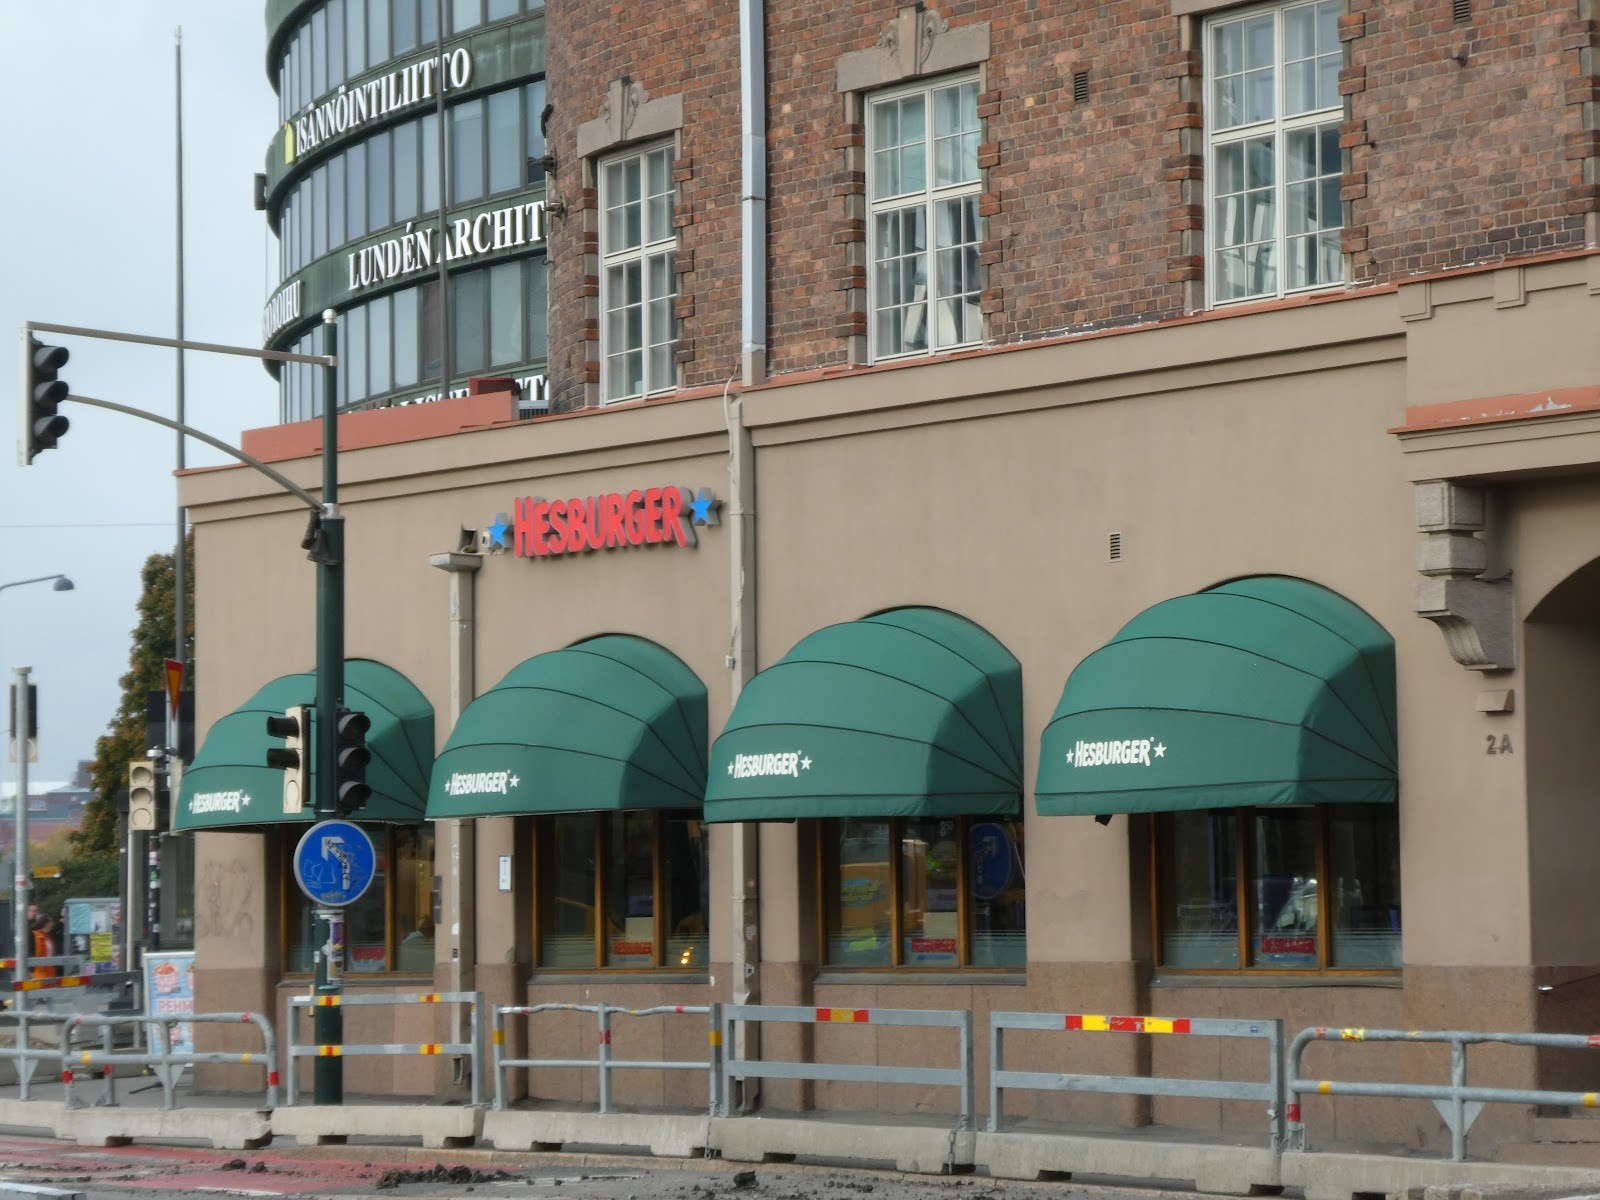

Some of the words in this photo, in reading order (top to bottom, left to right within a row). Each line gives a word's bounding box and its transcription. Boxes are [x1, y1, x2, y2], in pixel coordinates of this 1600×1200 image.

[348, 221, 433, 290] LUNDÉN
[435, 200, 549, 264] ARCHIT
[513, 485, 688, 559] HESBURGER
[733, 752, 799, 779] HESBURGER
[1074, 739, 1151, 768] HESBURGER
[449, 771, 508, 796] HESBURGER
[192, 791, 240, 815] HESBURGER
